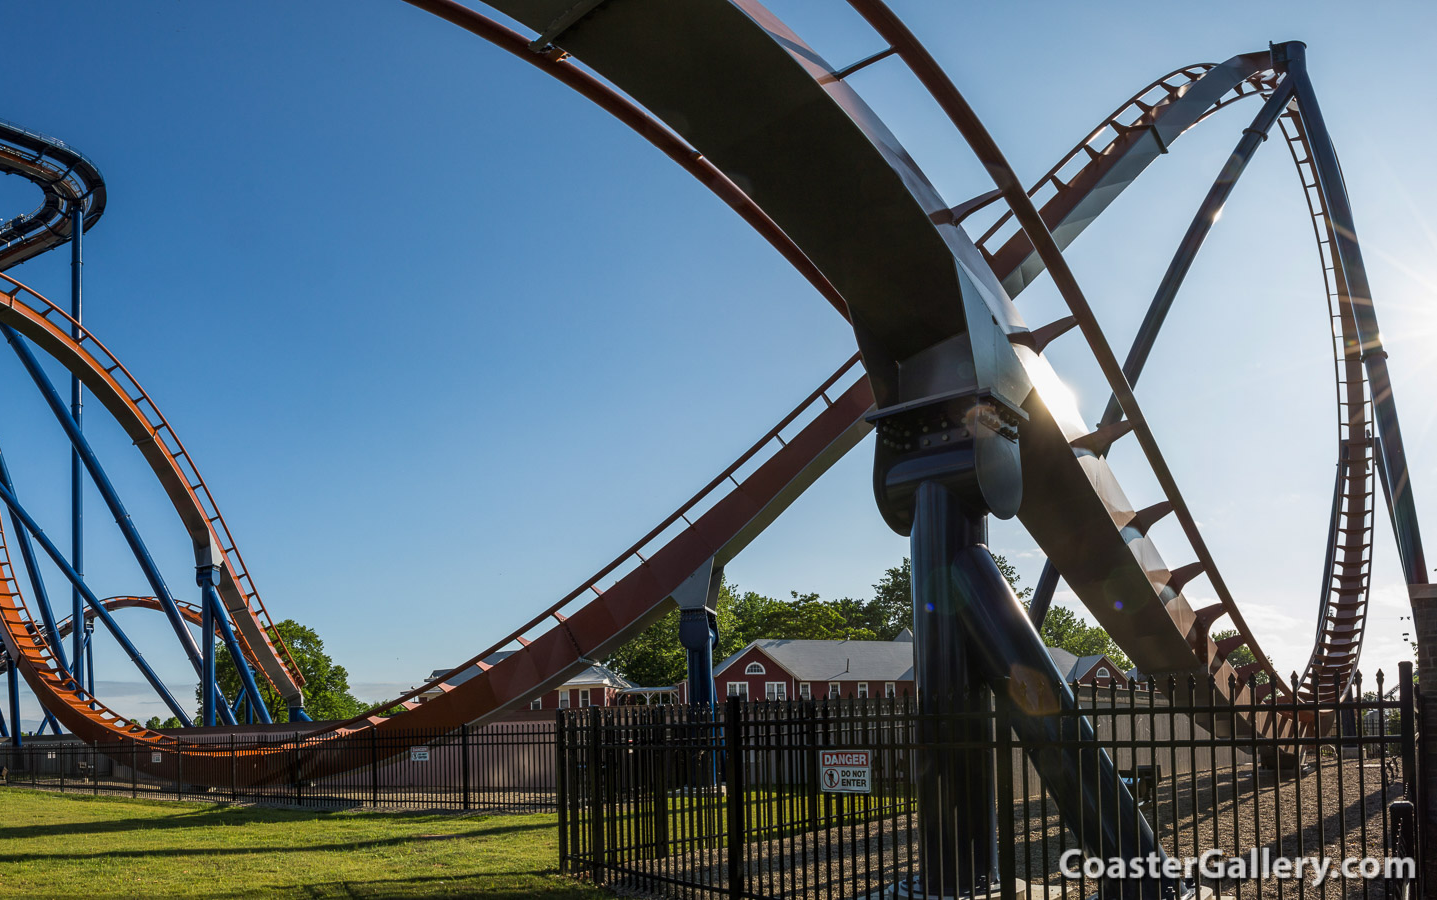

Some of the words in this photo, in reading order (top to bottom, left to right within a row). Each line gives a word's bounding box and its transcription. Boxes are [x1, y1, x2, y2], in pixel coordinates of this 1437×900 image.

[824, 754, 867, 765] DANGER
[841, 770, 851, 778] DO
[852, 770, 867, 778] NOT
[841, 779, 867, 787] ENTER
